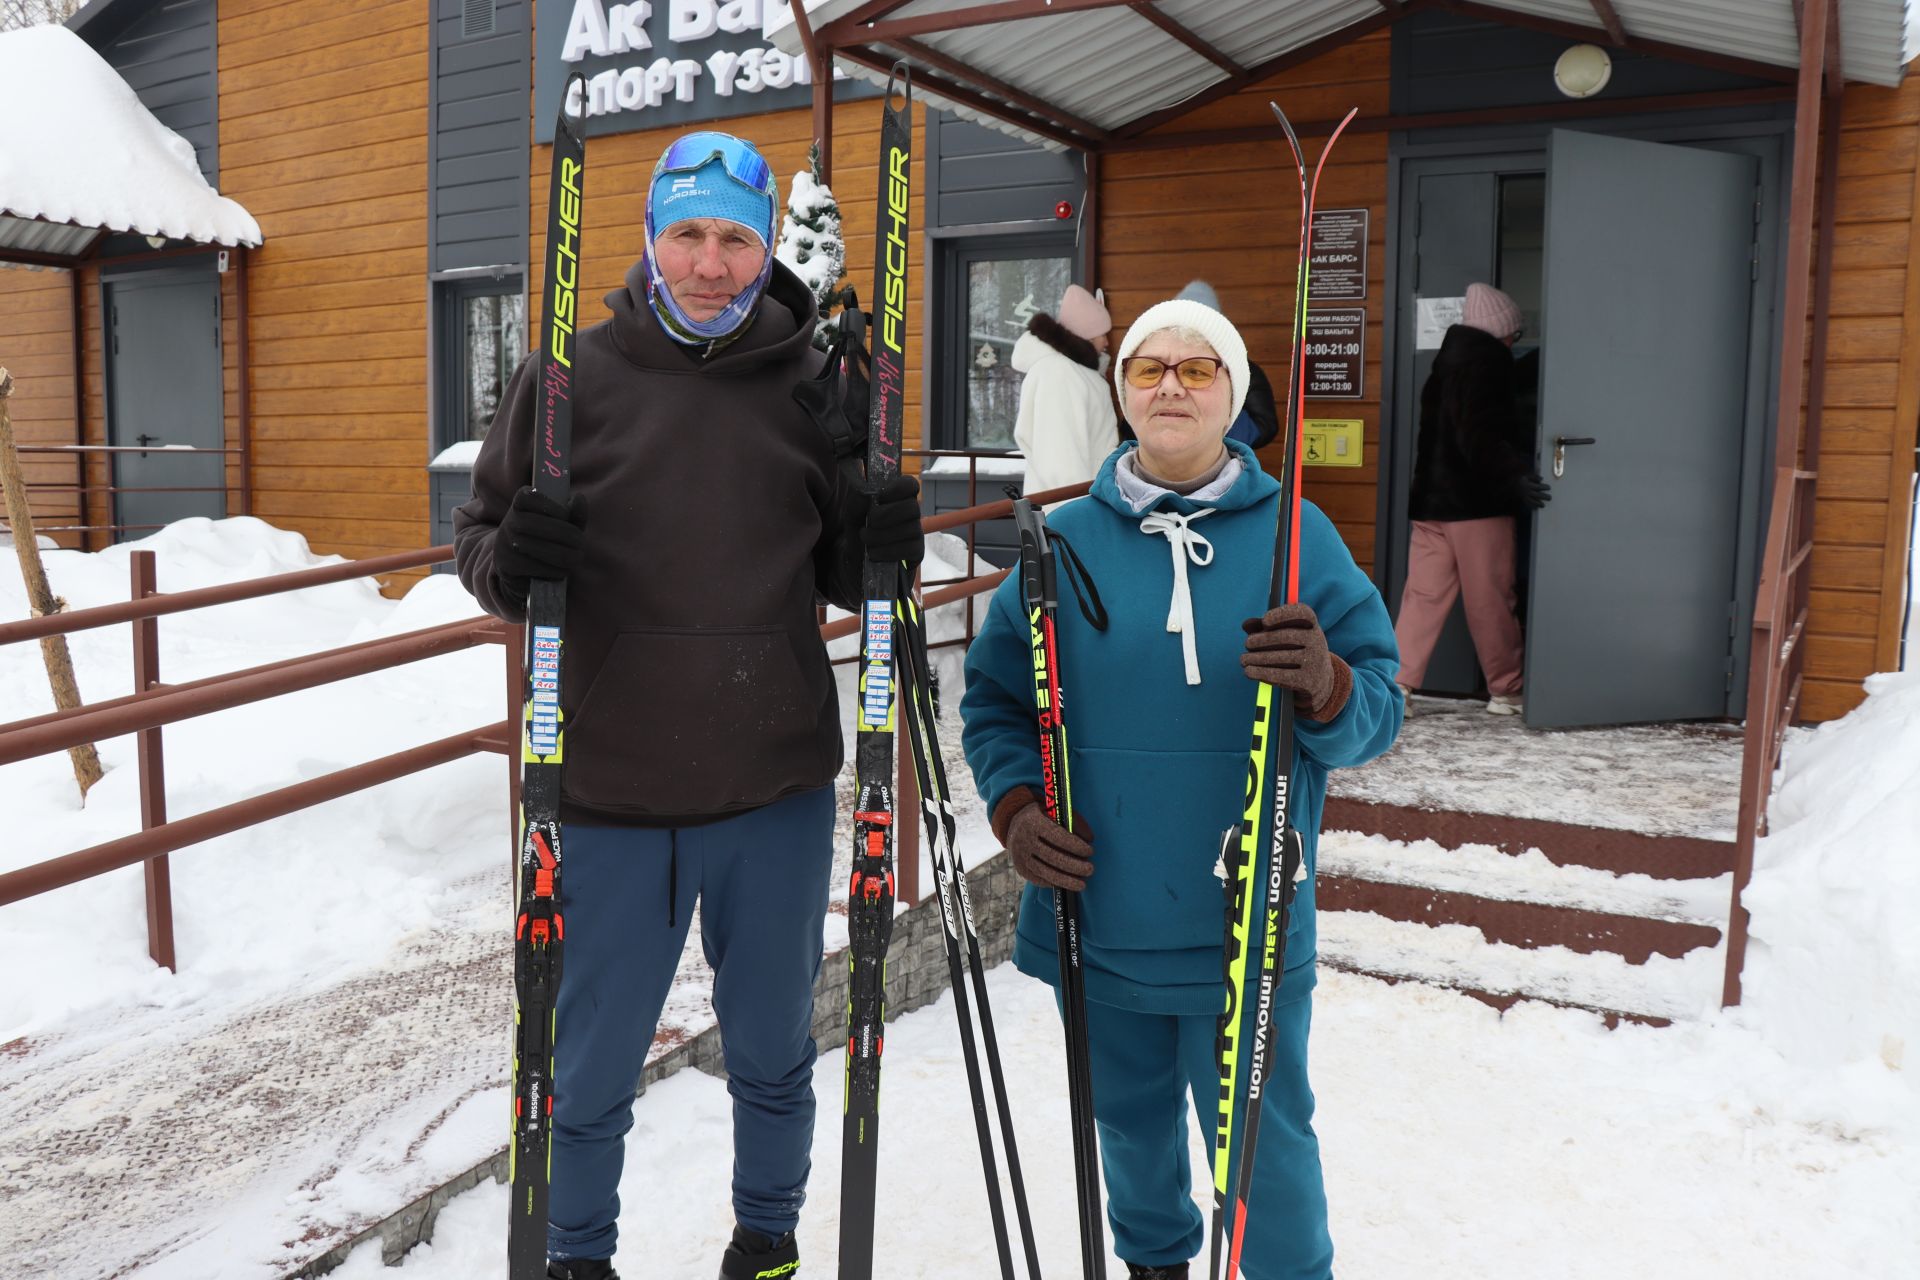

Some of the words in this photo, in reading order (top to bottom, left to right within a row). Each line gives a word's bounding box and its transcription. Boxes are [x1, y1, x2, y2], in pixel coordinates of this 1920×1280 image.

[561, 0, 652, 62] Ак
[664, 189, 711, 206] NORDSKI
[884, 147, 909, 353] FISCHER
[1329, 254, 1358, 263] БАРС»
[551, 157, 582, 368] FISCHER
[1305, 343, 1360, 355] 8:00-21:00
[1310, 382, 1352, 391] 12:00-13:00
[880, 786, 890, 806] PRO
[548, 821, 558, 839] PRO
[939, 871, 956, 928] SPORT
[862, 1023, 870, 1058] ROSSIGNOL
